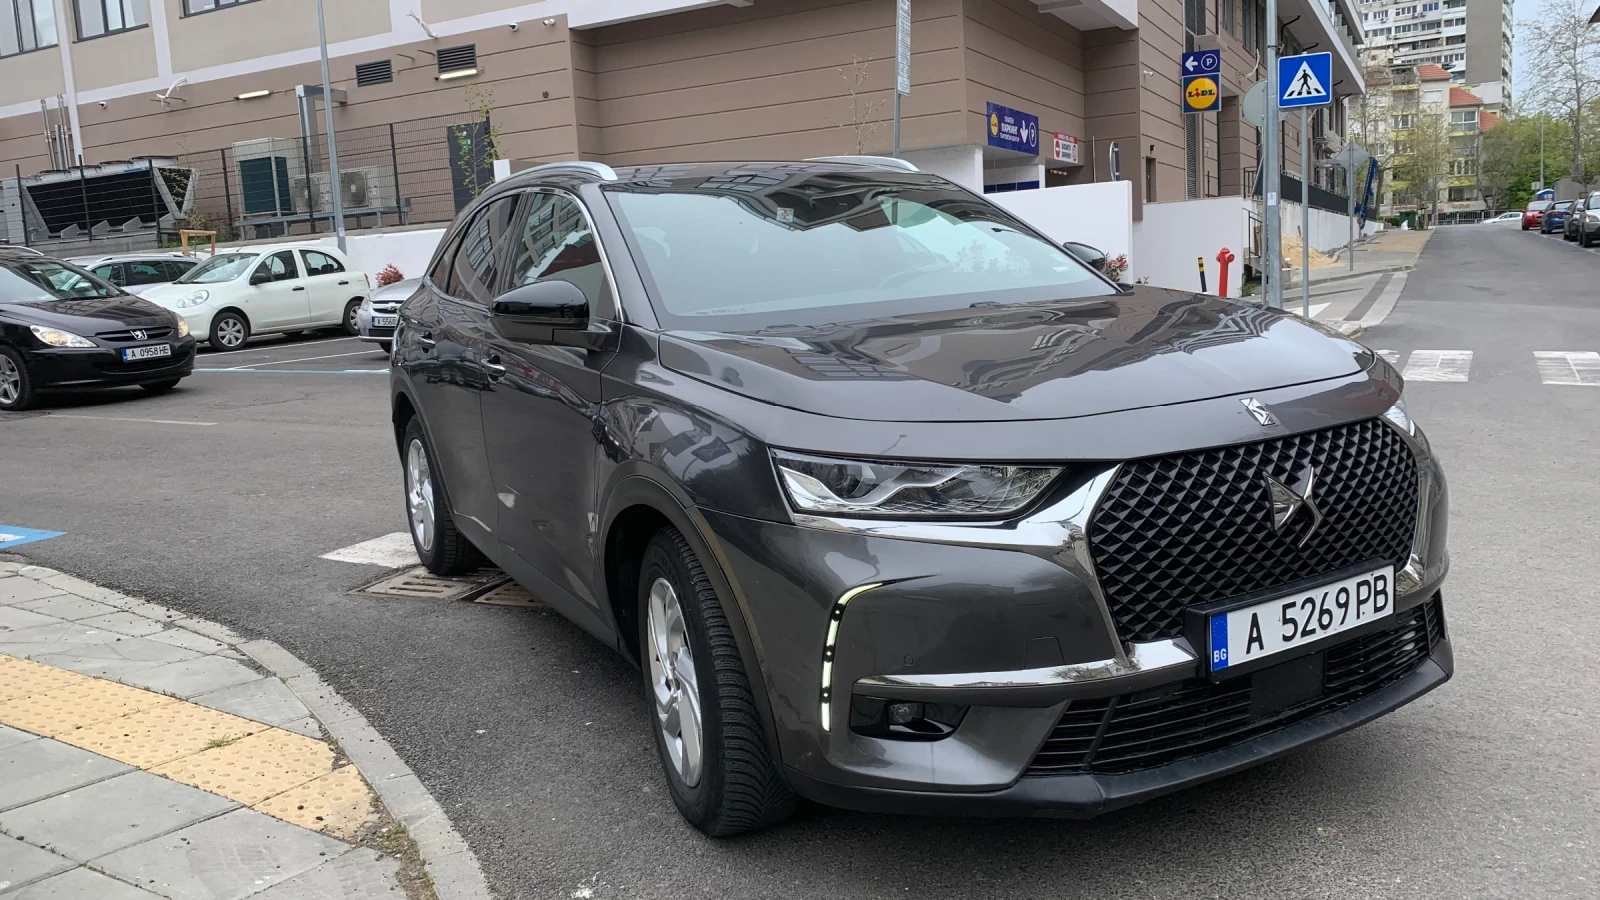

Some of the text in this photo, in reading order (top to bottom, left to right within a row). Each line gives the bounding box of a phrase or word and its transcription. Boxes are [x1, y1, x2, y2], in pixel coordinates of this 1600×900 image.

[1206, 58, 1213, 66] P
[131, 350, 137, 359] A
[140, 347, 159, 358] 0958
[1245, 612, 1265, 655] A
[1213, 648, 1227, 663] BG
